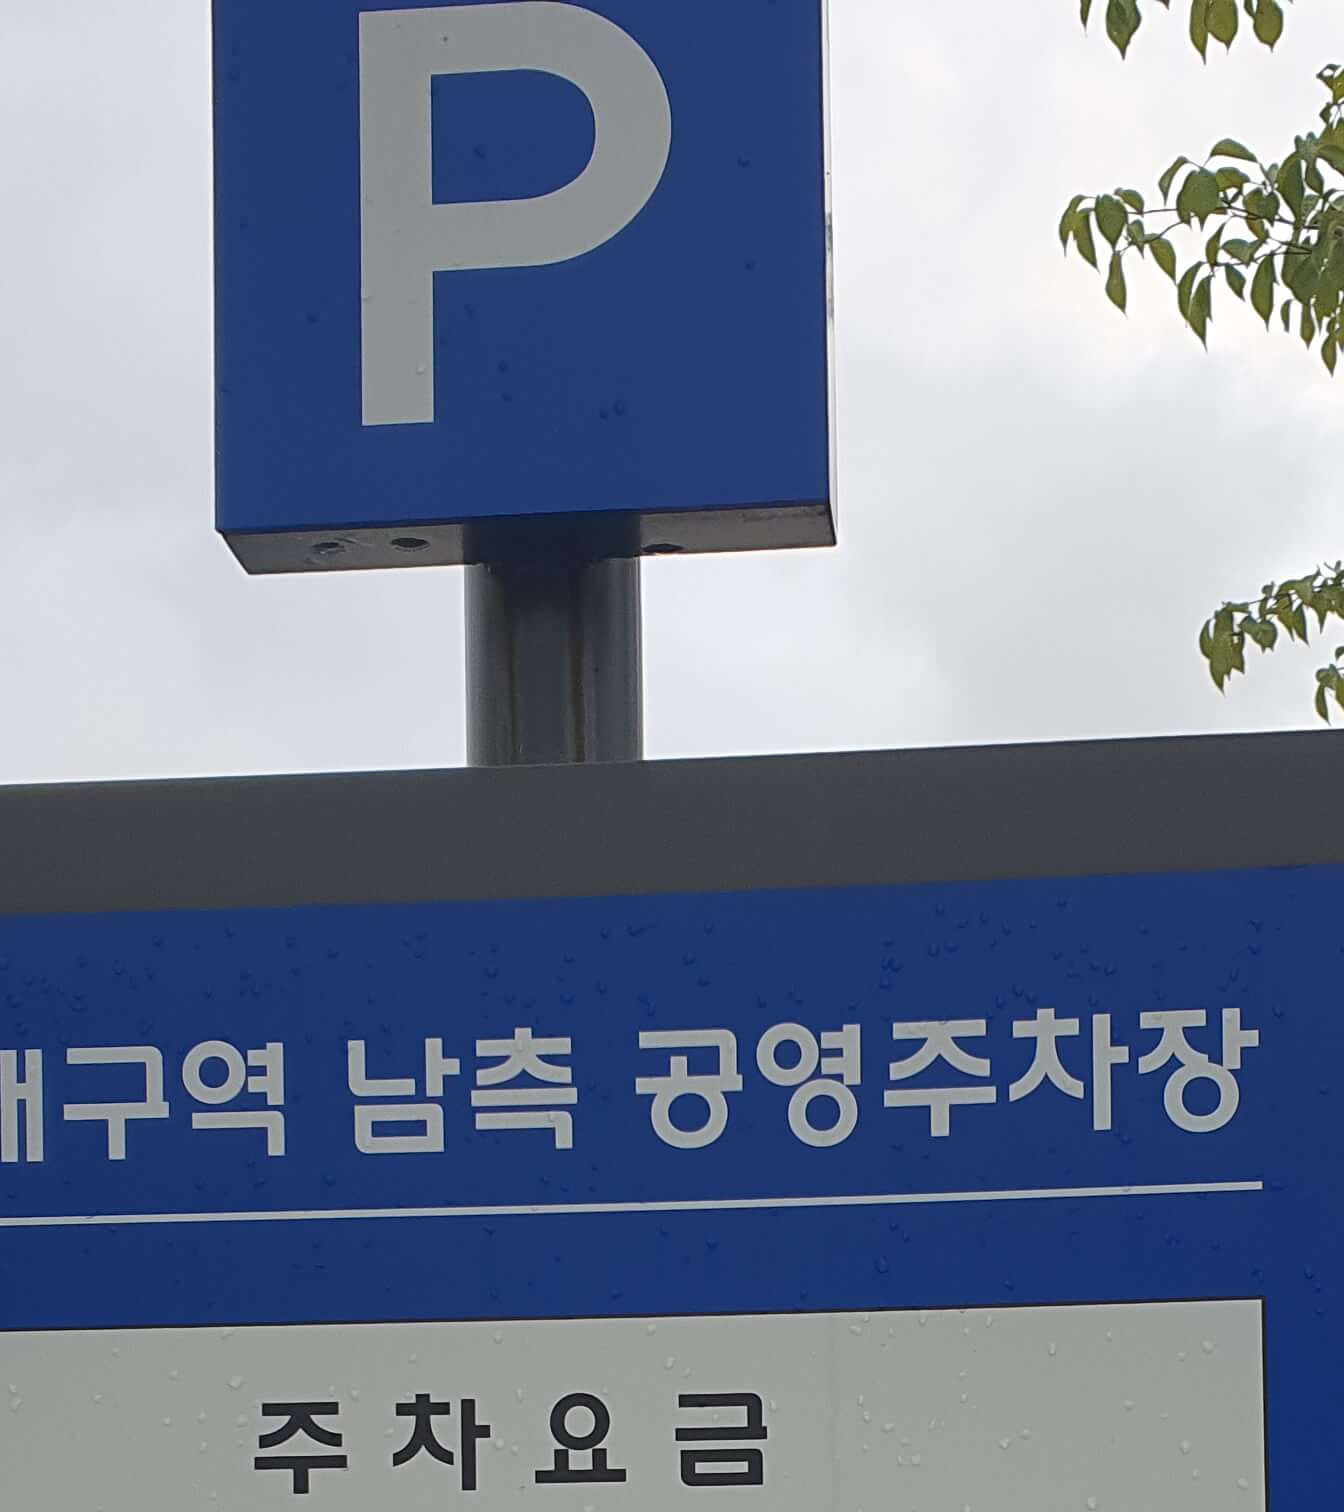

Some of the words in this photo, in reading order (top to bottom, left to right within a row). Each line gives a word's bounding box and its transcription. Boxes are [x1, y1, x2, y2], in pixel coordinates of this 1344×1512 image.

[359, 1, 672, 427] P
[347, 1027, 578, 1154] 남측
[634, 1007, 1259, 1149] 공영주차장
